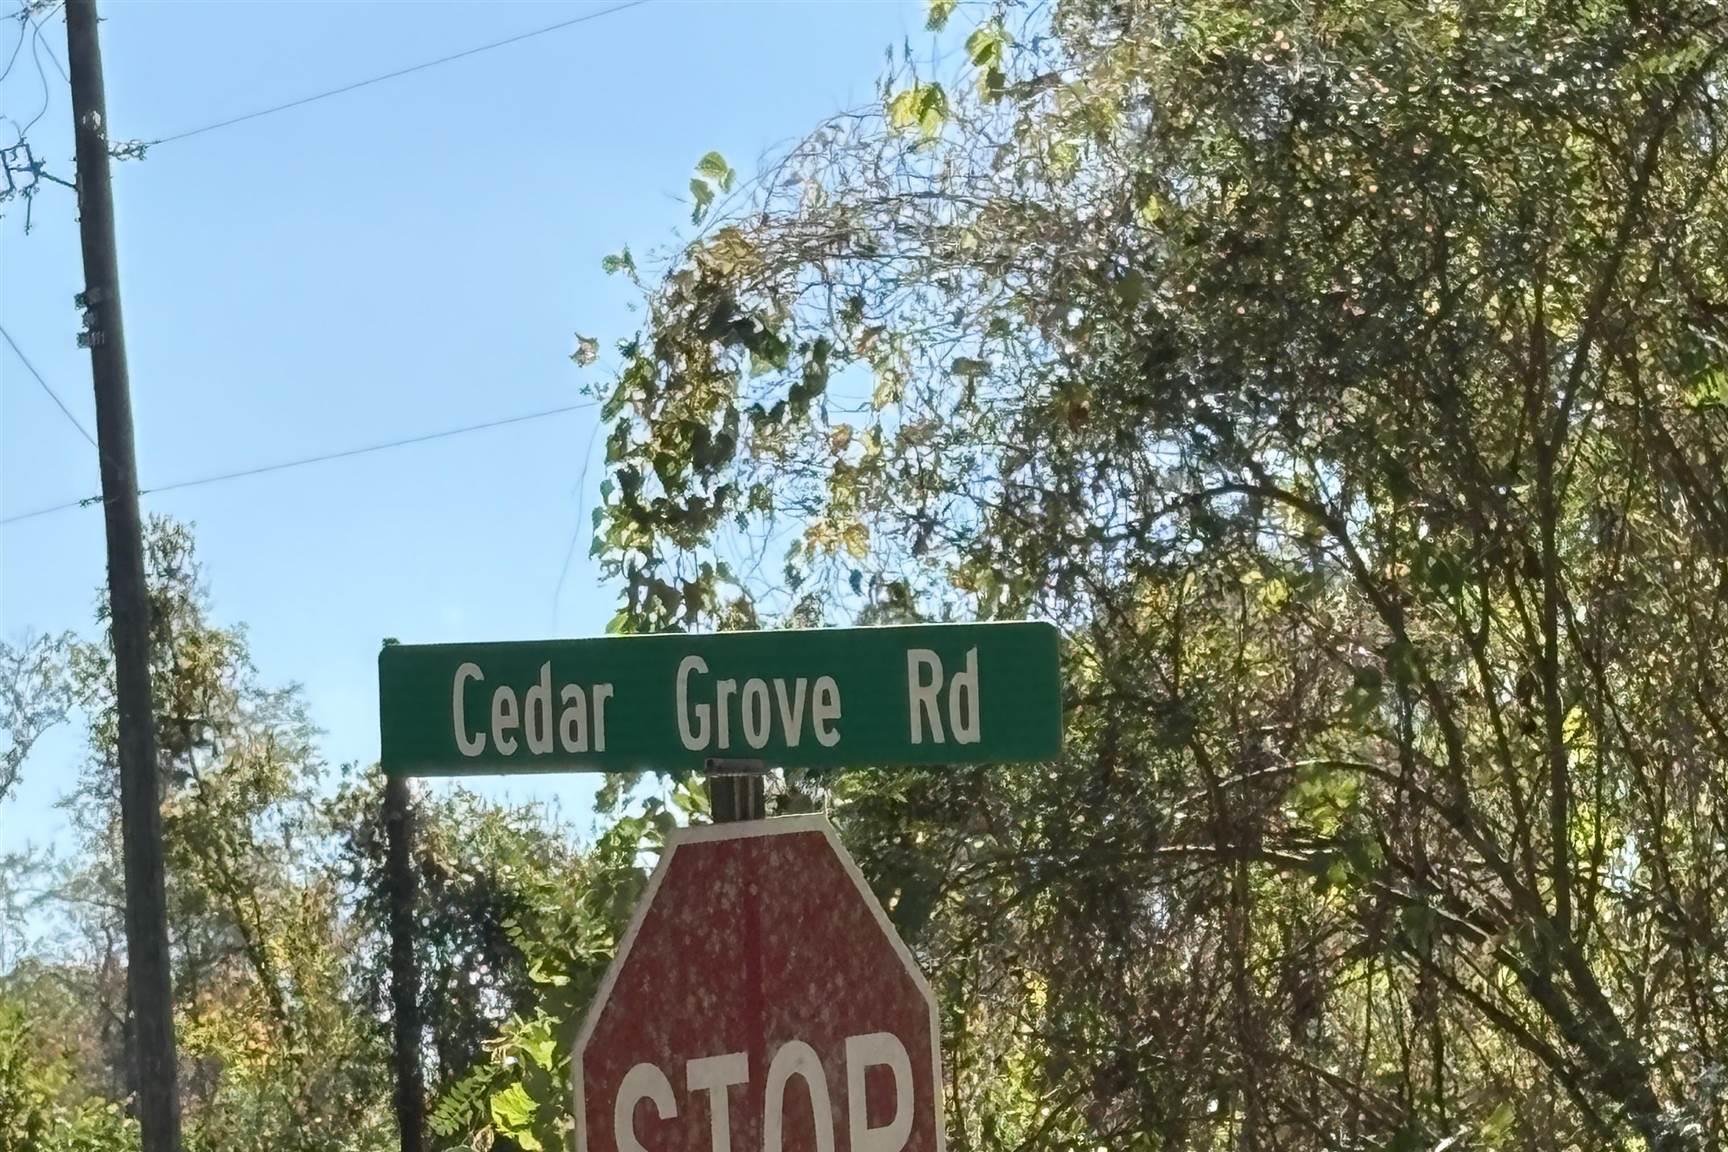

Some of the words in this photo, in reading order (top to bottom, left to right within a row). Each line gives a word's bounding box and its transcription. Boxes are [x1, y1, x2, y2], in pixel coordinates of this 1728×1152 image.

[452, 659, 614, 757] Cedar
[675, 654, 842, 752] Grove
[906, 645, 981, 746] Rd
